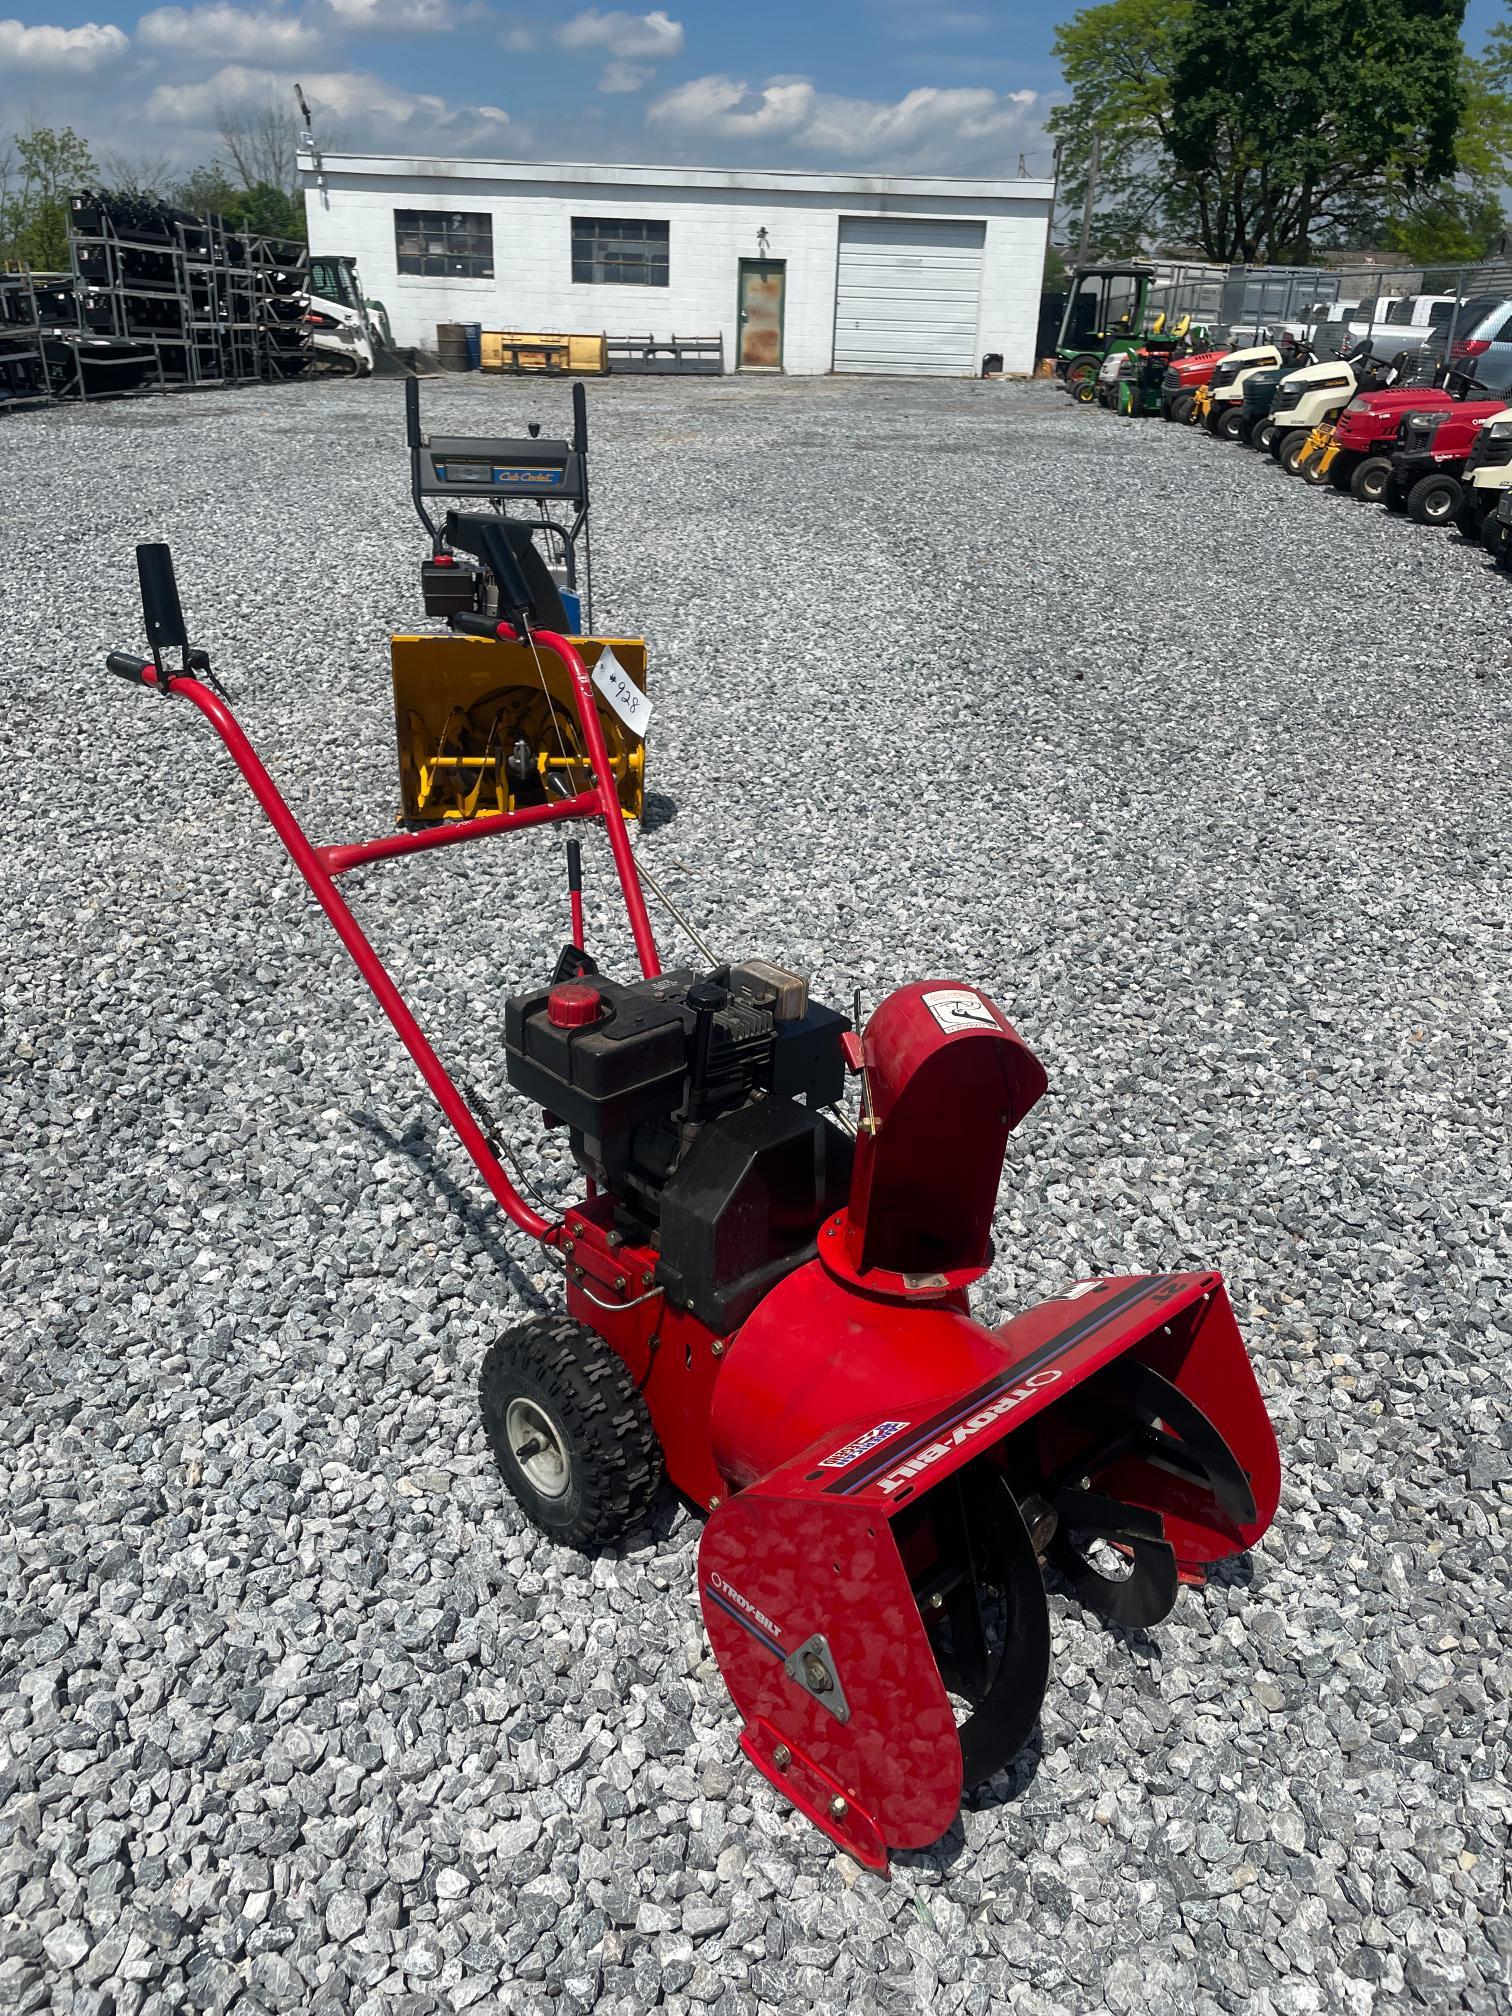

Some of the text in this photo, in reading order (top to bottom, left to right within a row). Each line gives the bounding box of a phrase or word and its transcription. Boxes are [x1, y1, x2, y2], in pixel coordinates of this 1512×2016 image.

[498, 472, 521, 482] Cub
[822, 1443, 861, 1465] LEGEND
[836, 1429, 895, 1466] AMERICAN
[876, 1387, 1039, 1494] TROY-BILT
[722, 1581, 782, 1638] TROY-BILT
